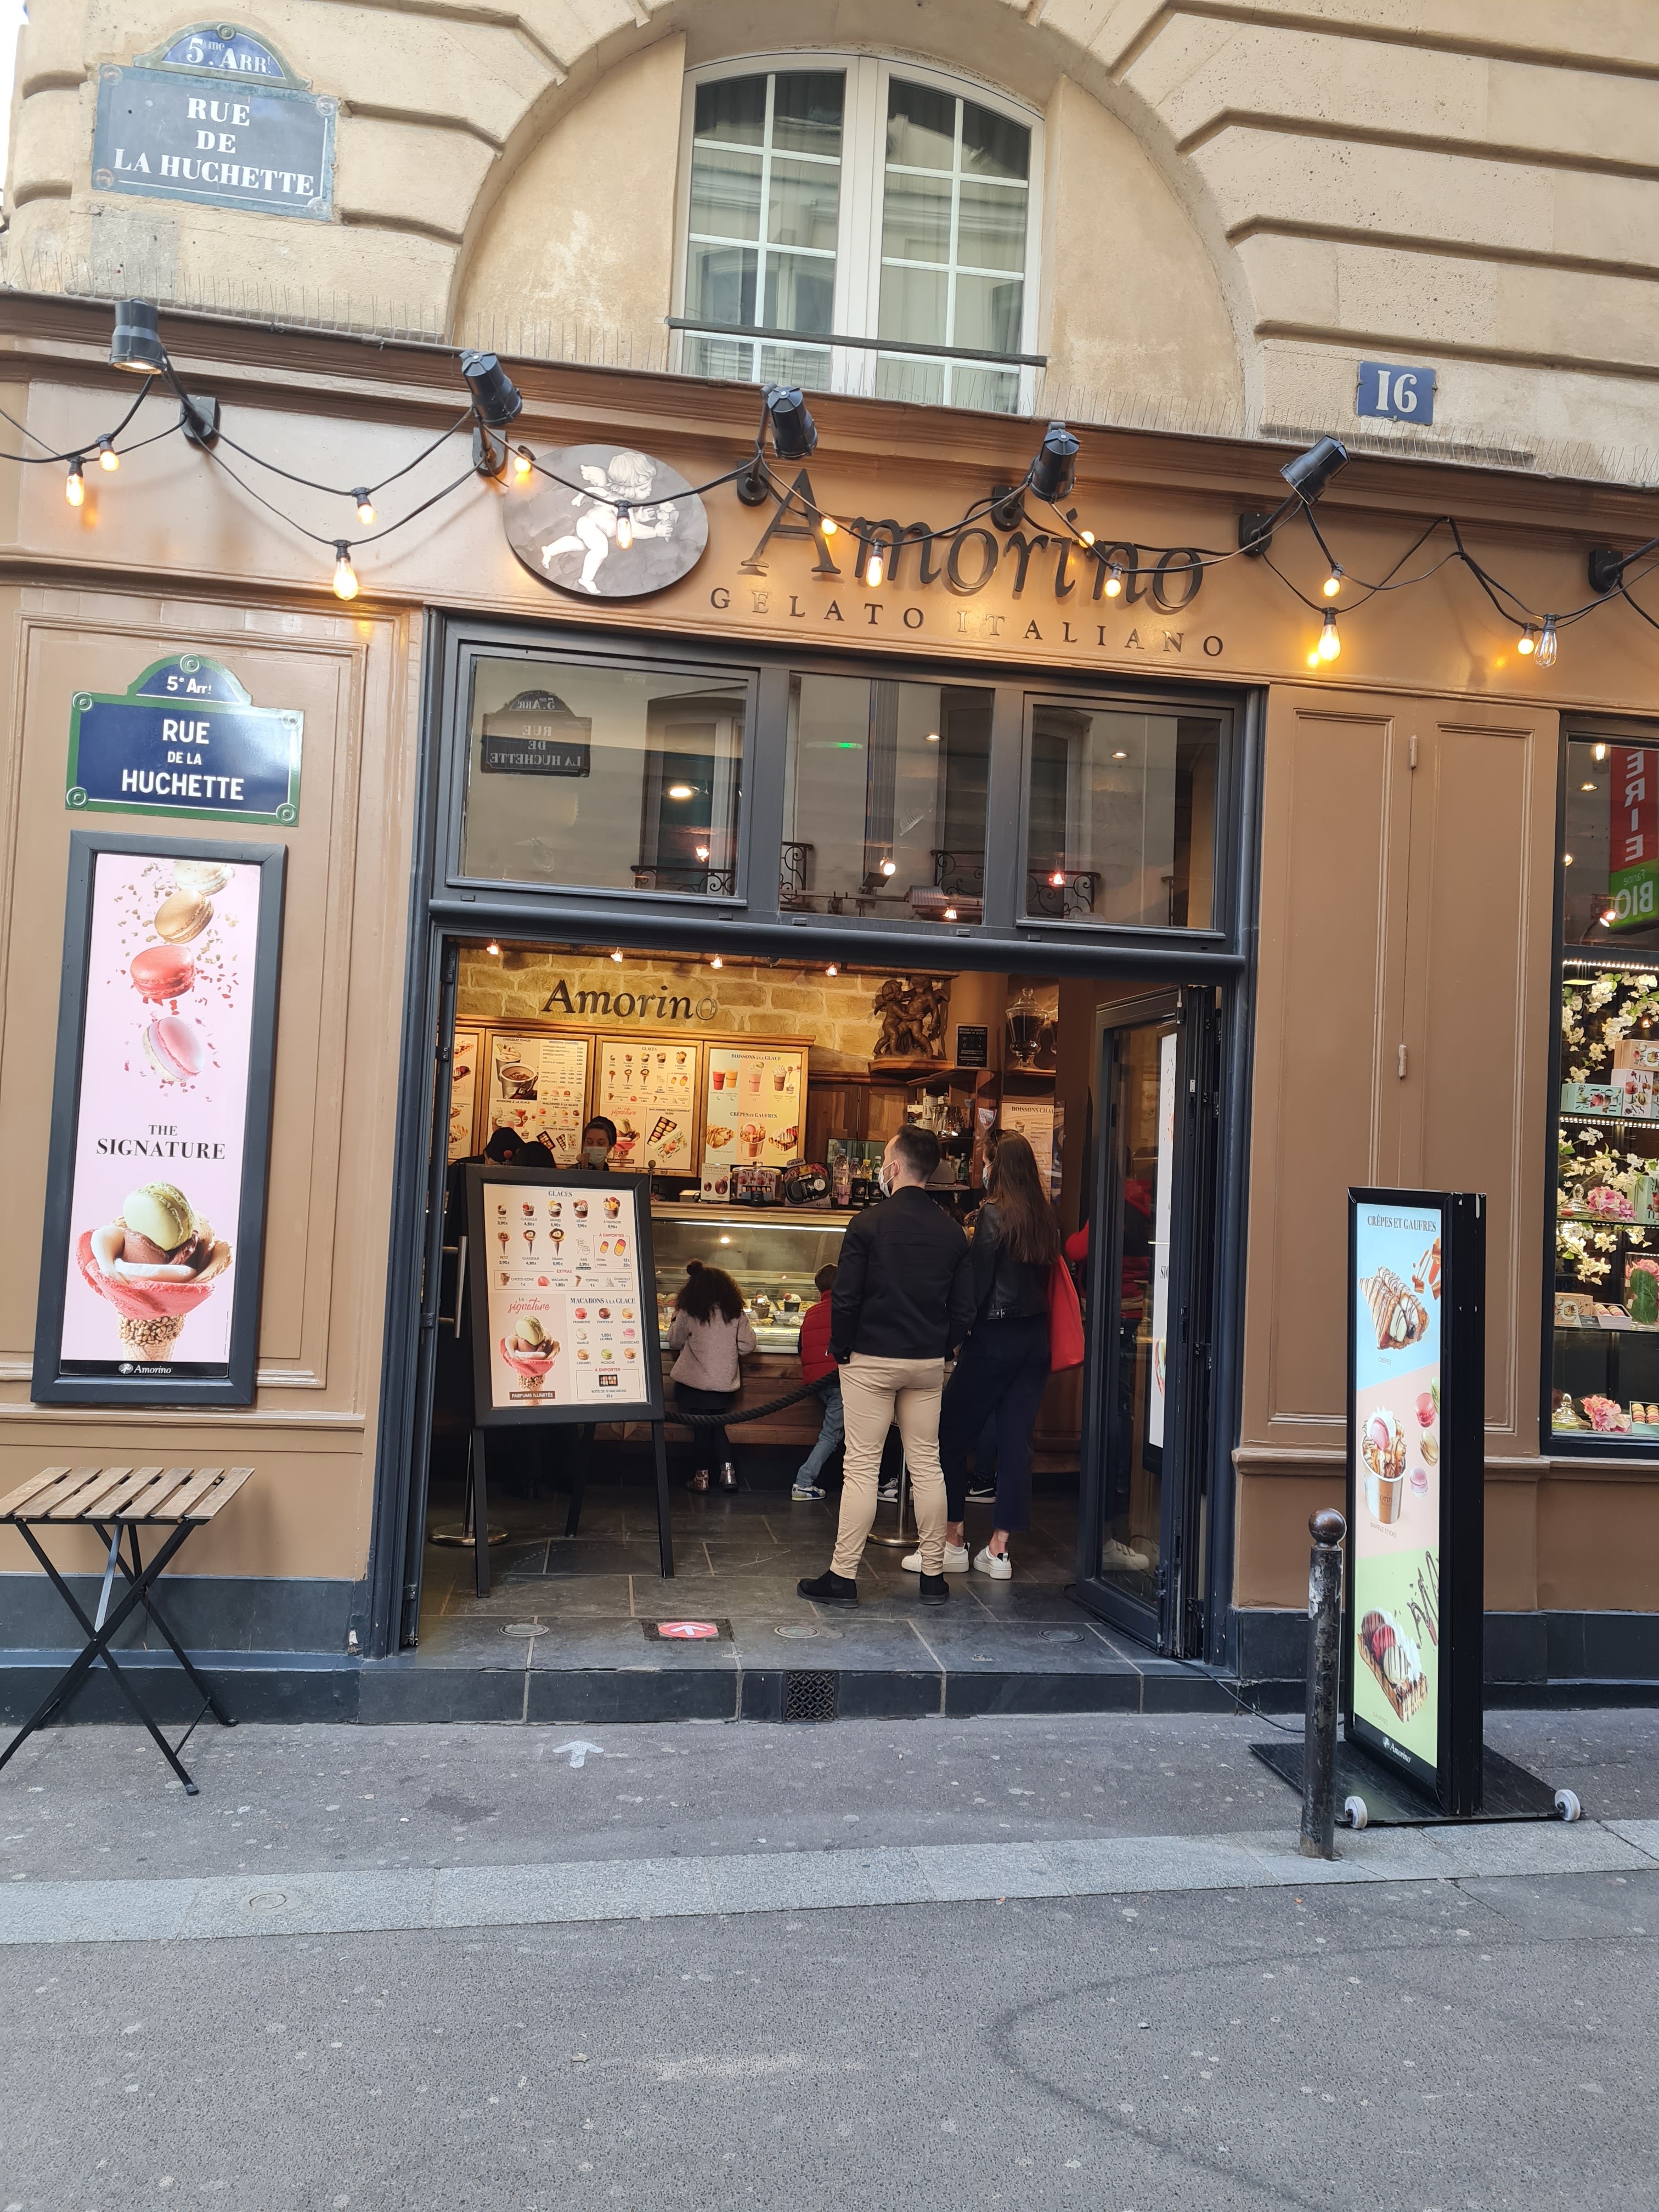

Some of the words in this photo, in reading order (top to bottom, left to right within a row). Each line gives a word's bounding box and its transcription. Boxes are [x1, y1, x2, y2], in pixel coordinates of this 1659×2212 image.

[186, 98, 250, 126] RUE
[195, 130, 236, 154] DE
[113, 148, 151, 173] LA
[159, 155, 313, 196] HUCHETTE
[1376, 370, 1418, 413] 16
[741, 468, 1203, 610] Amorino
[710, 587, 925, 629] GELATO
[956, 610, 1225, 657] ITALIANO
[162, 719, 210, 744] RUE
[167, 751, 183, 764] DE
[187, 752, 202, 765] LA
[121, 769, 244, 801] HUCHETTE
[540, 979, 717, 1020] Amorino
[148, 1125, 178, 1136] THE
[96, 1138, 225, 1160] SIGNATURE
[1394, 1217, 1402, 1229] ET
[1404, 1218, 1436, 1232] GAUFRES
[507, 1297, 551, 1314] signature
[133, 1364, 172, 1374] Amorino
[1390, 1743, 1411, 1763] Amorino
